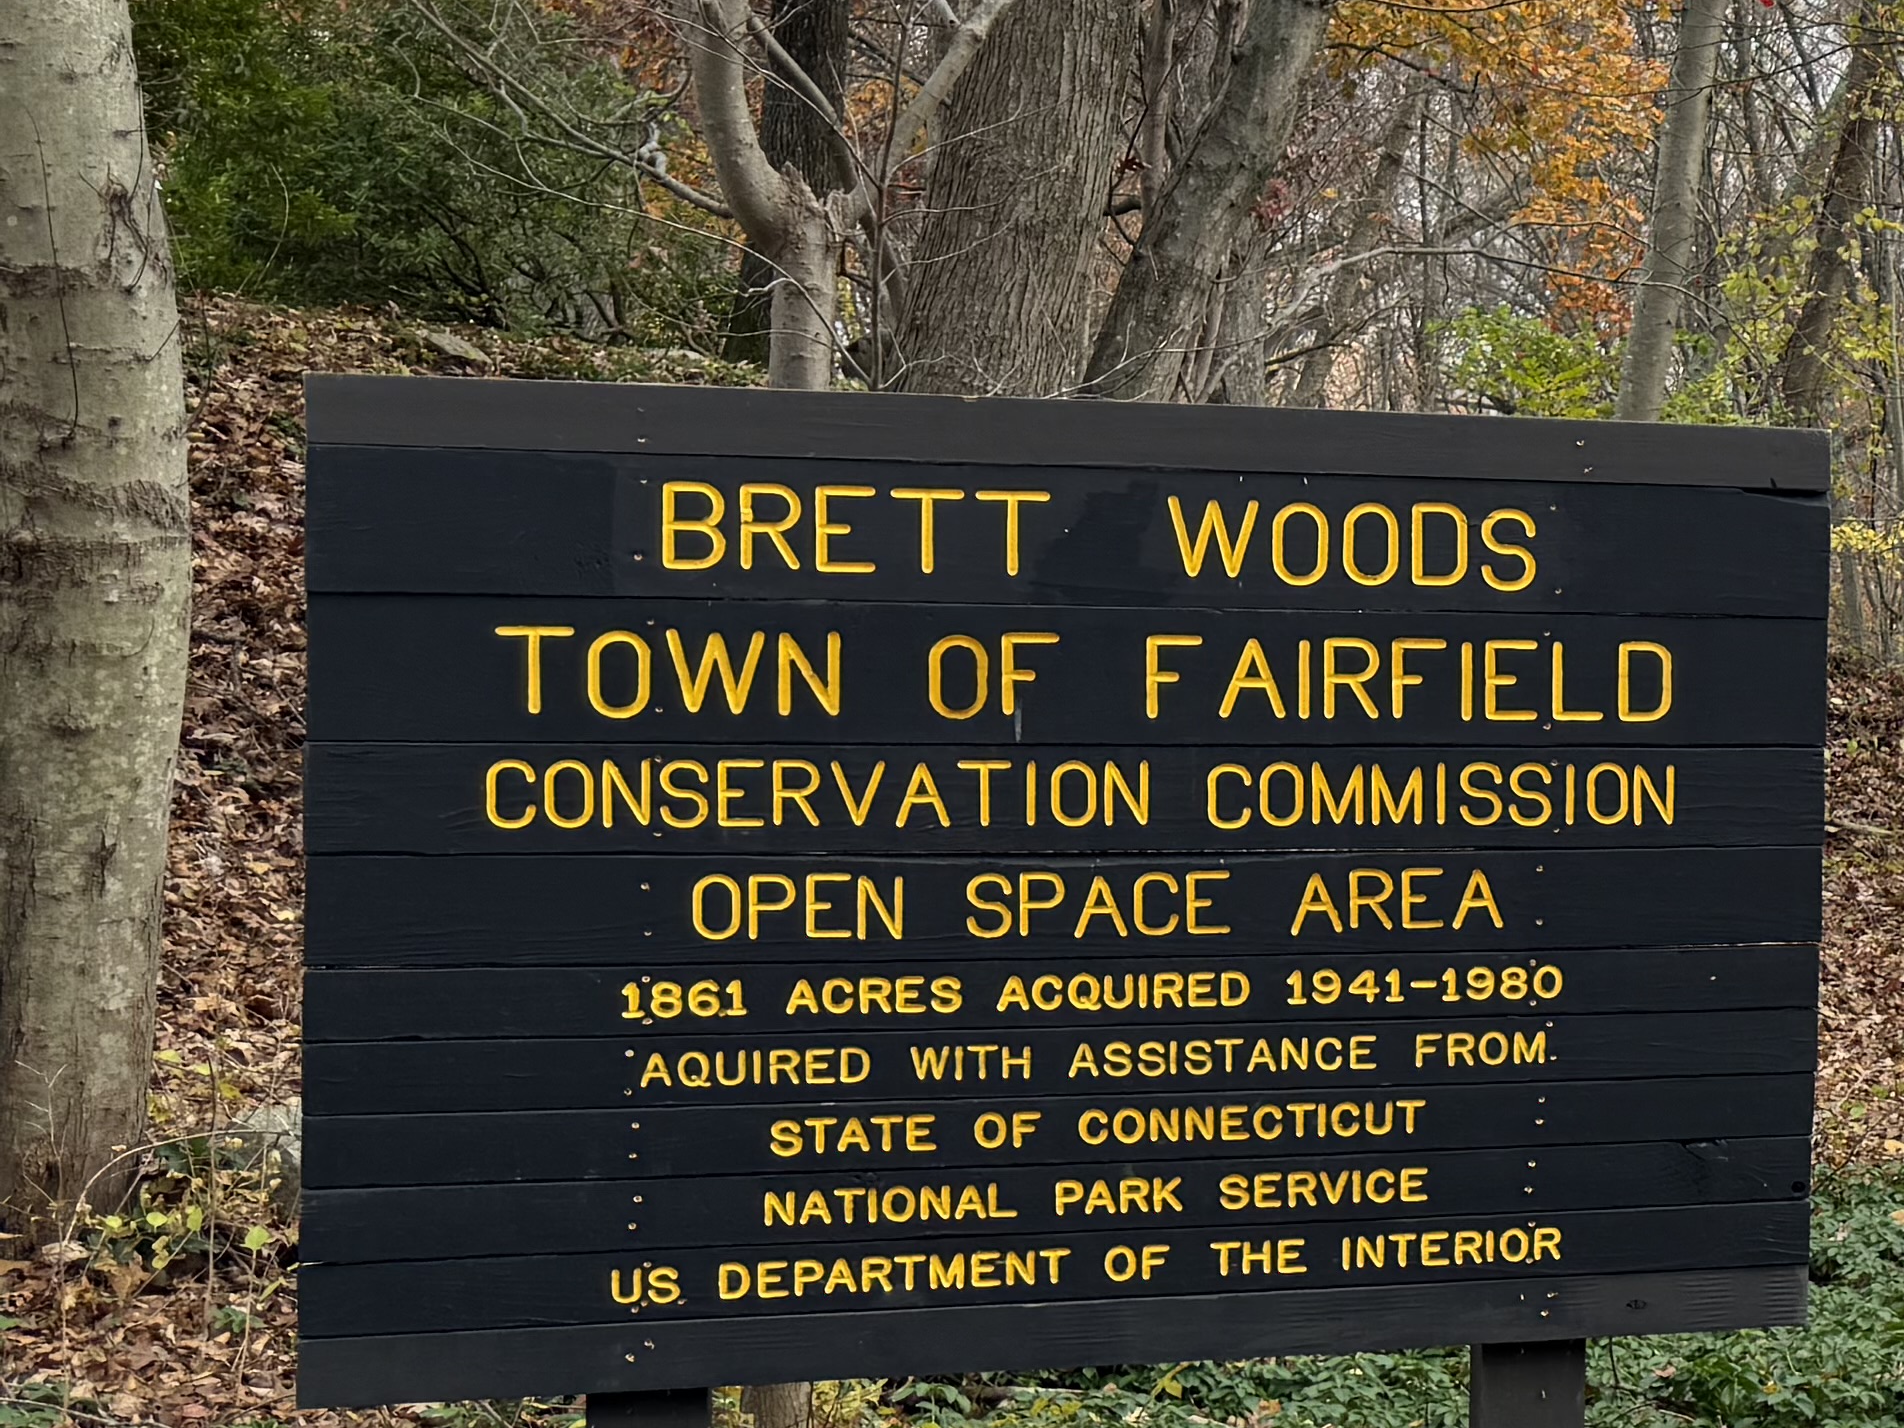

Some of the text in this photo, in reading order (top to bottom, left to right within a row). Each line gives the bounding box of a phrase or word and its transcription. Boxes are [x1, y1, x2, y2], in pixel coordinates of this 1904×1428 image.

[663, 480, 1537, 592] BRETT WOODS
[496, 625, 1673, 723] TOWN OF FAIRFIELD
[485, 758, 1675, 830] CONSERVATION COMMISSION
[693, 867, 1504, 941] OPEN SPACE AREA
[624, 964, 1563, 1019] 1861 ACRES ACQUIRED 1941-1980
[642, 1031, 1546, 1088] AQUIRED WITH ASSISTANCE FROM
[771, 1099, 1427, 1158] STATE OF CONNECTICUT
[765, 1167, 1429, 1227] NATIONAL PARK SERVICE
[612, 1227, 1562, 1304] US DEPARTMENT OF THE INTERIOR
